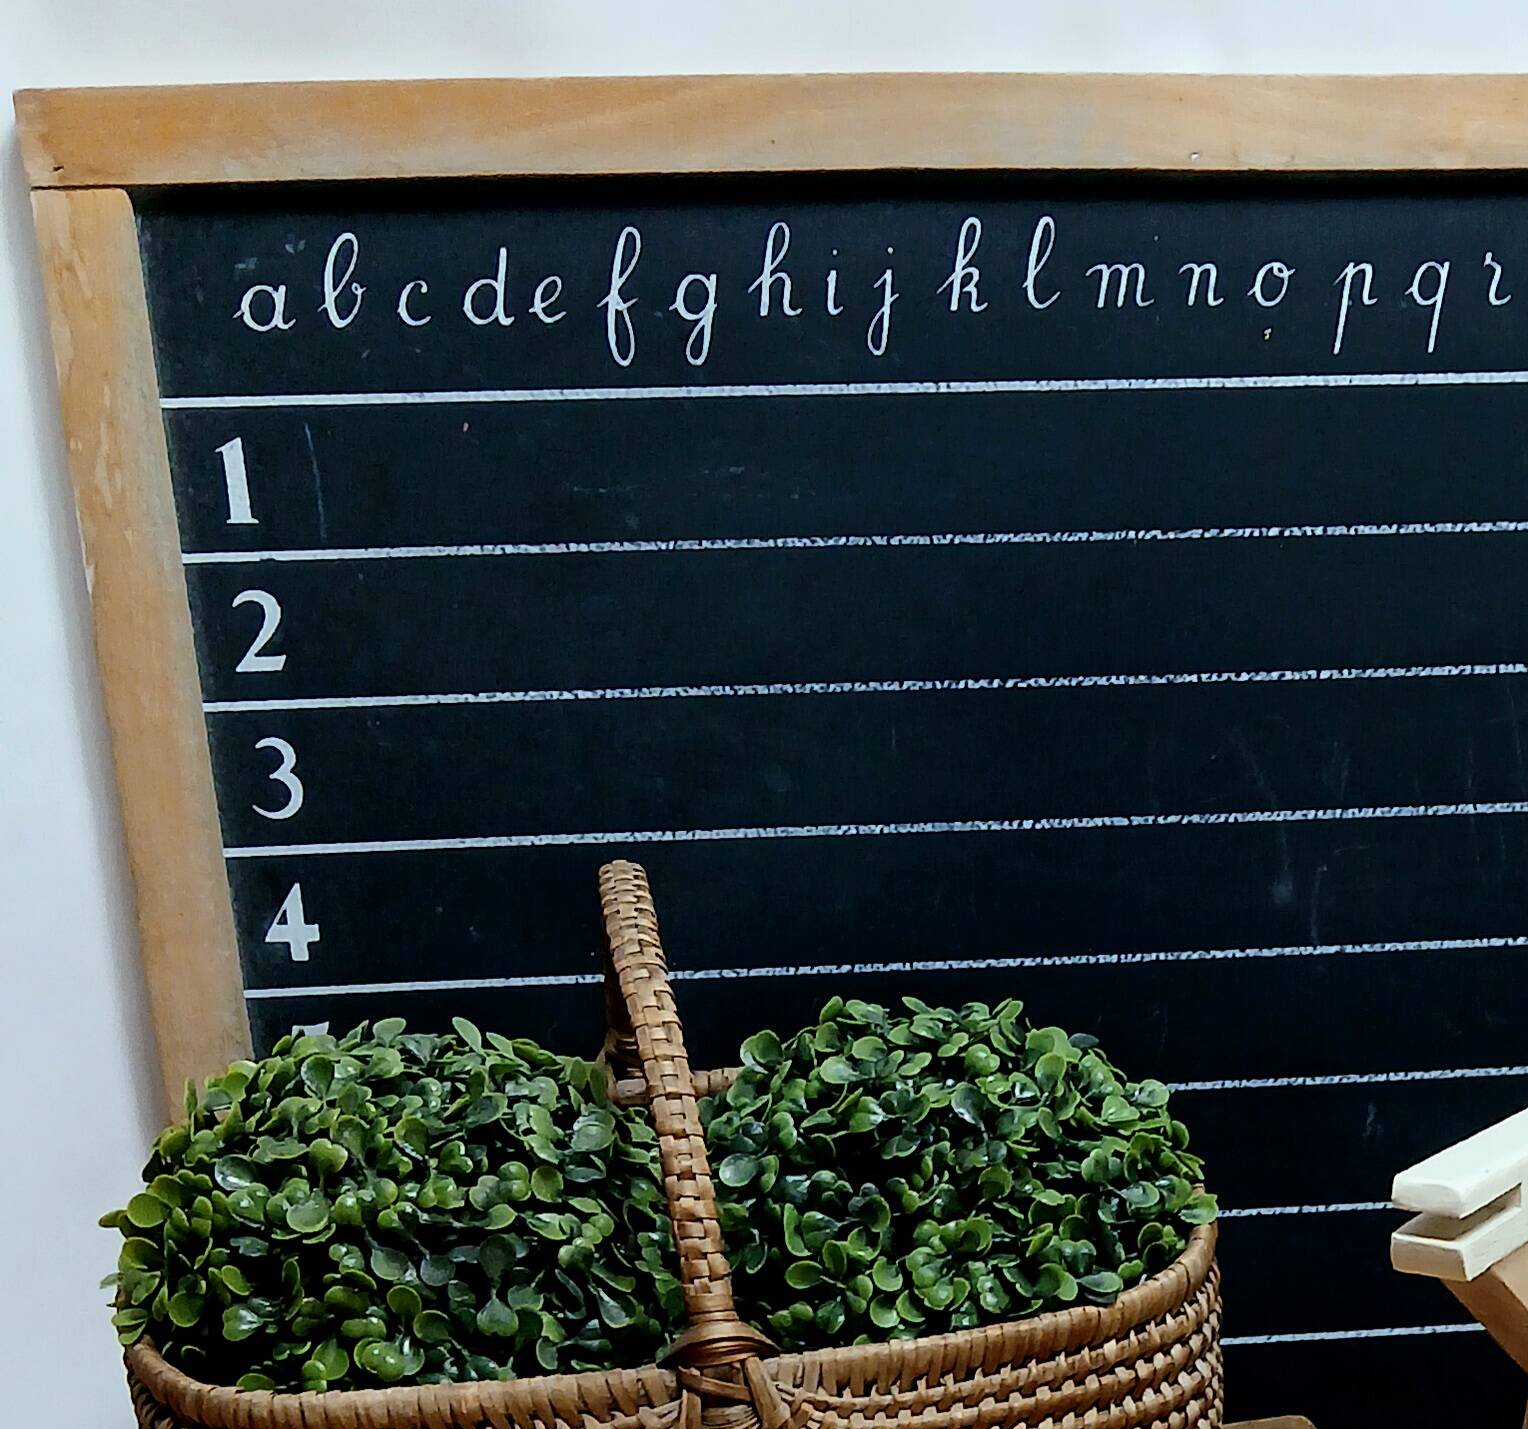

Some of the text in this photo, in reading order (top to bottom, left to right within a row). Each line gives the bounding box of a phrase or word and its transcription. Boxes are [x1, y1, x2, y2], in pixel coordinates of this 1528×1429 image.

[231, 284, 297, 332] a
[318, 232, 367, 329] b
[396, 280, 433, 326] c
[462, 247, 515, 326] d
[528, 275, 567, 324] e
[596, 226, 642, 367] f
[668, 272, 718, 366] g
[747, 222, 803, 318] h
[825, 248, 844, 316] i
[867, 247, 900, 356] j
[937, 216, 989, 313] k
[1022, 215, 1061, 310] l
[1085, 262, 1155, 309] m
[1178, 262, 1225, 307] n
[1247, 261, 1296, 307] o
[1332, 261, 1378, 355] p
[1404, 261, 1450, 354] q
[1480, 251, 1513, 306] r
[213, 437, 260, 525] 1
[231, 589, 287, 674] 2
[250, 736, 305, 820] 3
[264, 882, 321, 962] 4
